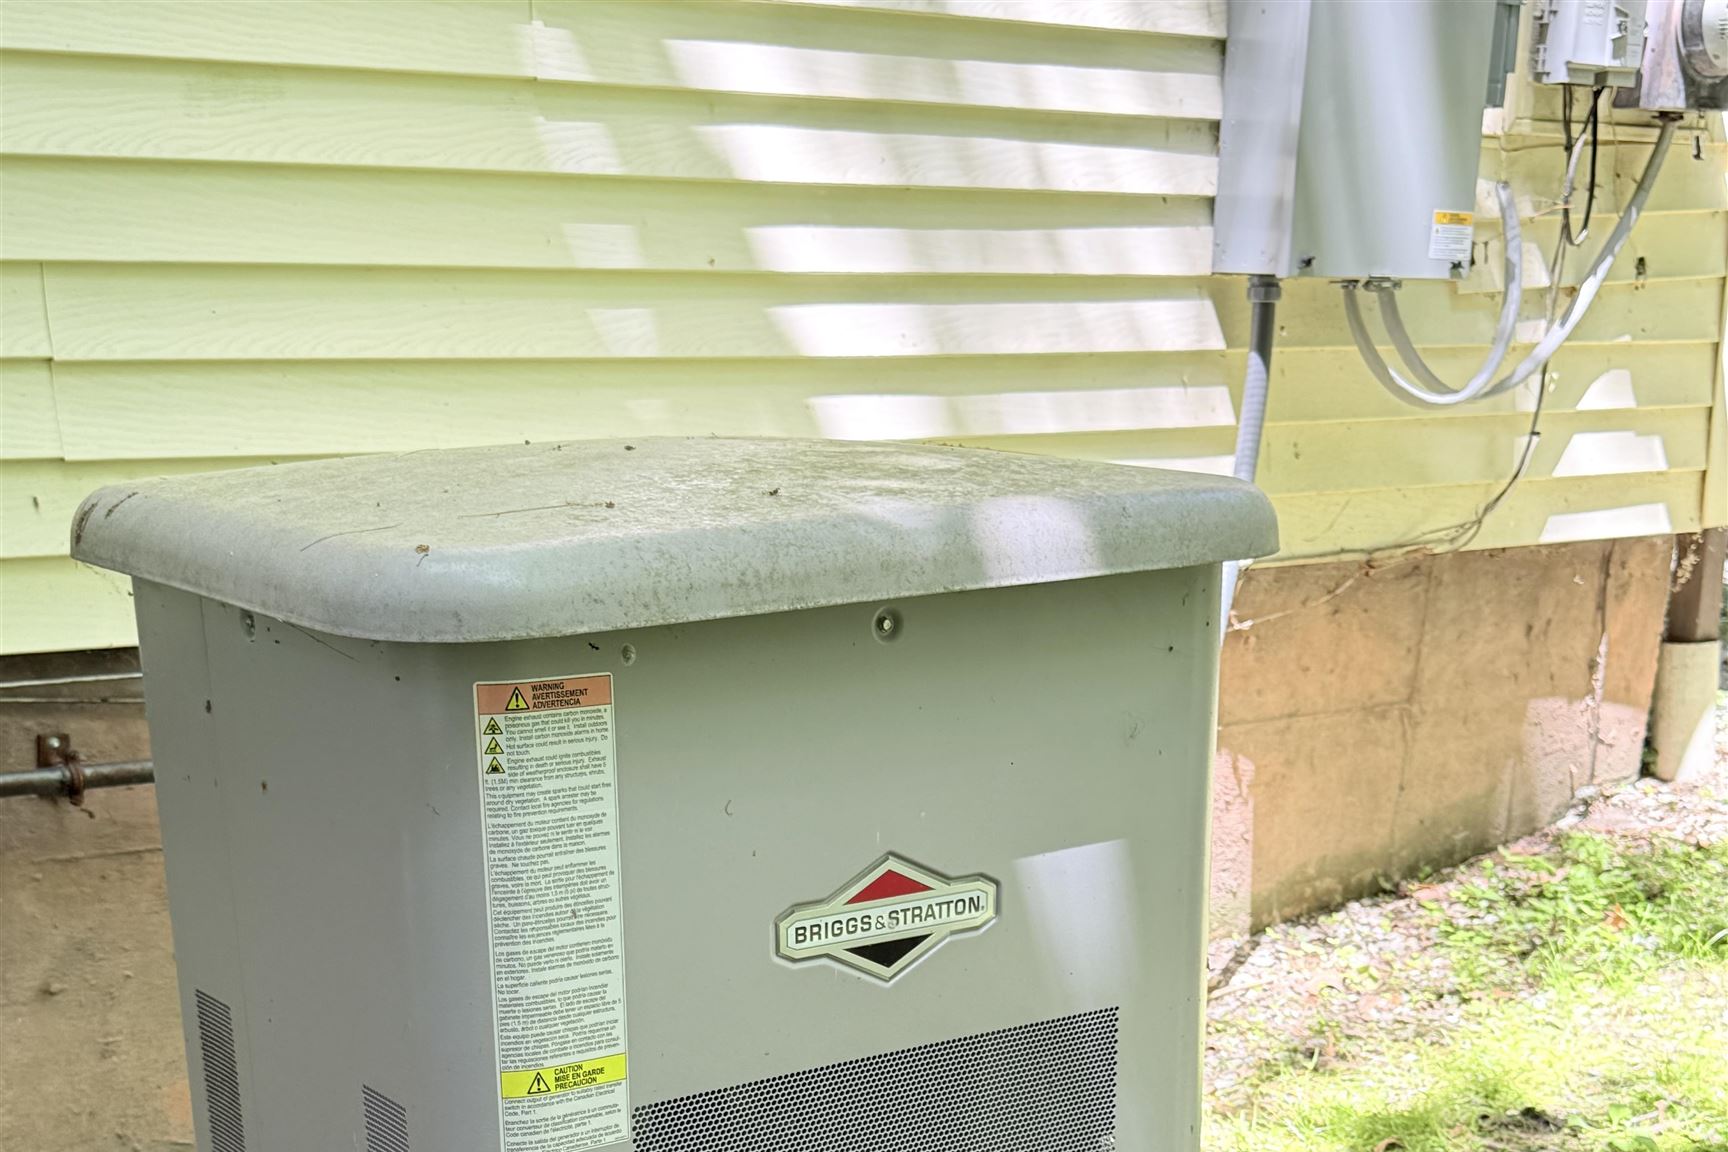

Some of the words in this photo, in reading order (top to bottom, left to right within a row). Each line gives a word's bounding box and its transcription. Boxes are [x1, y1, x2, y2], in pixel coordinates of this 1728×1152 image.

[531, 682, 565, 692] WARNING
[532, 689, 588, 700] AVERTISSEMENT
[533, 698, 581, 709] ADVERTENCIA
[794, 914, 872, 945] BRIGGS
[875, 915, 887, 930] &
[554, 1064, 584, 1076] CAUTION
[554, 1074, 571, 1083] MISE
[572, 1072, 582, 1080] EN
[582, 1067, 605, 1078] GARDE
[554, 1077, 598, 1091] PRECAUCIÓN
